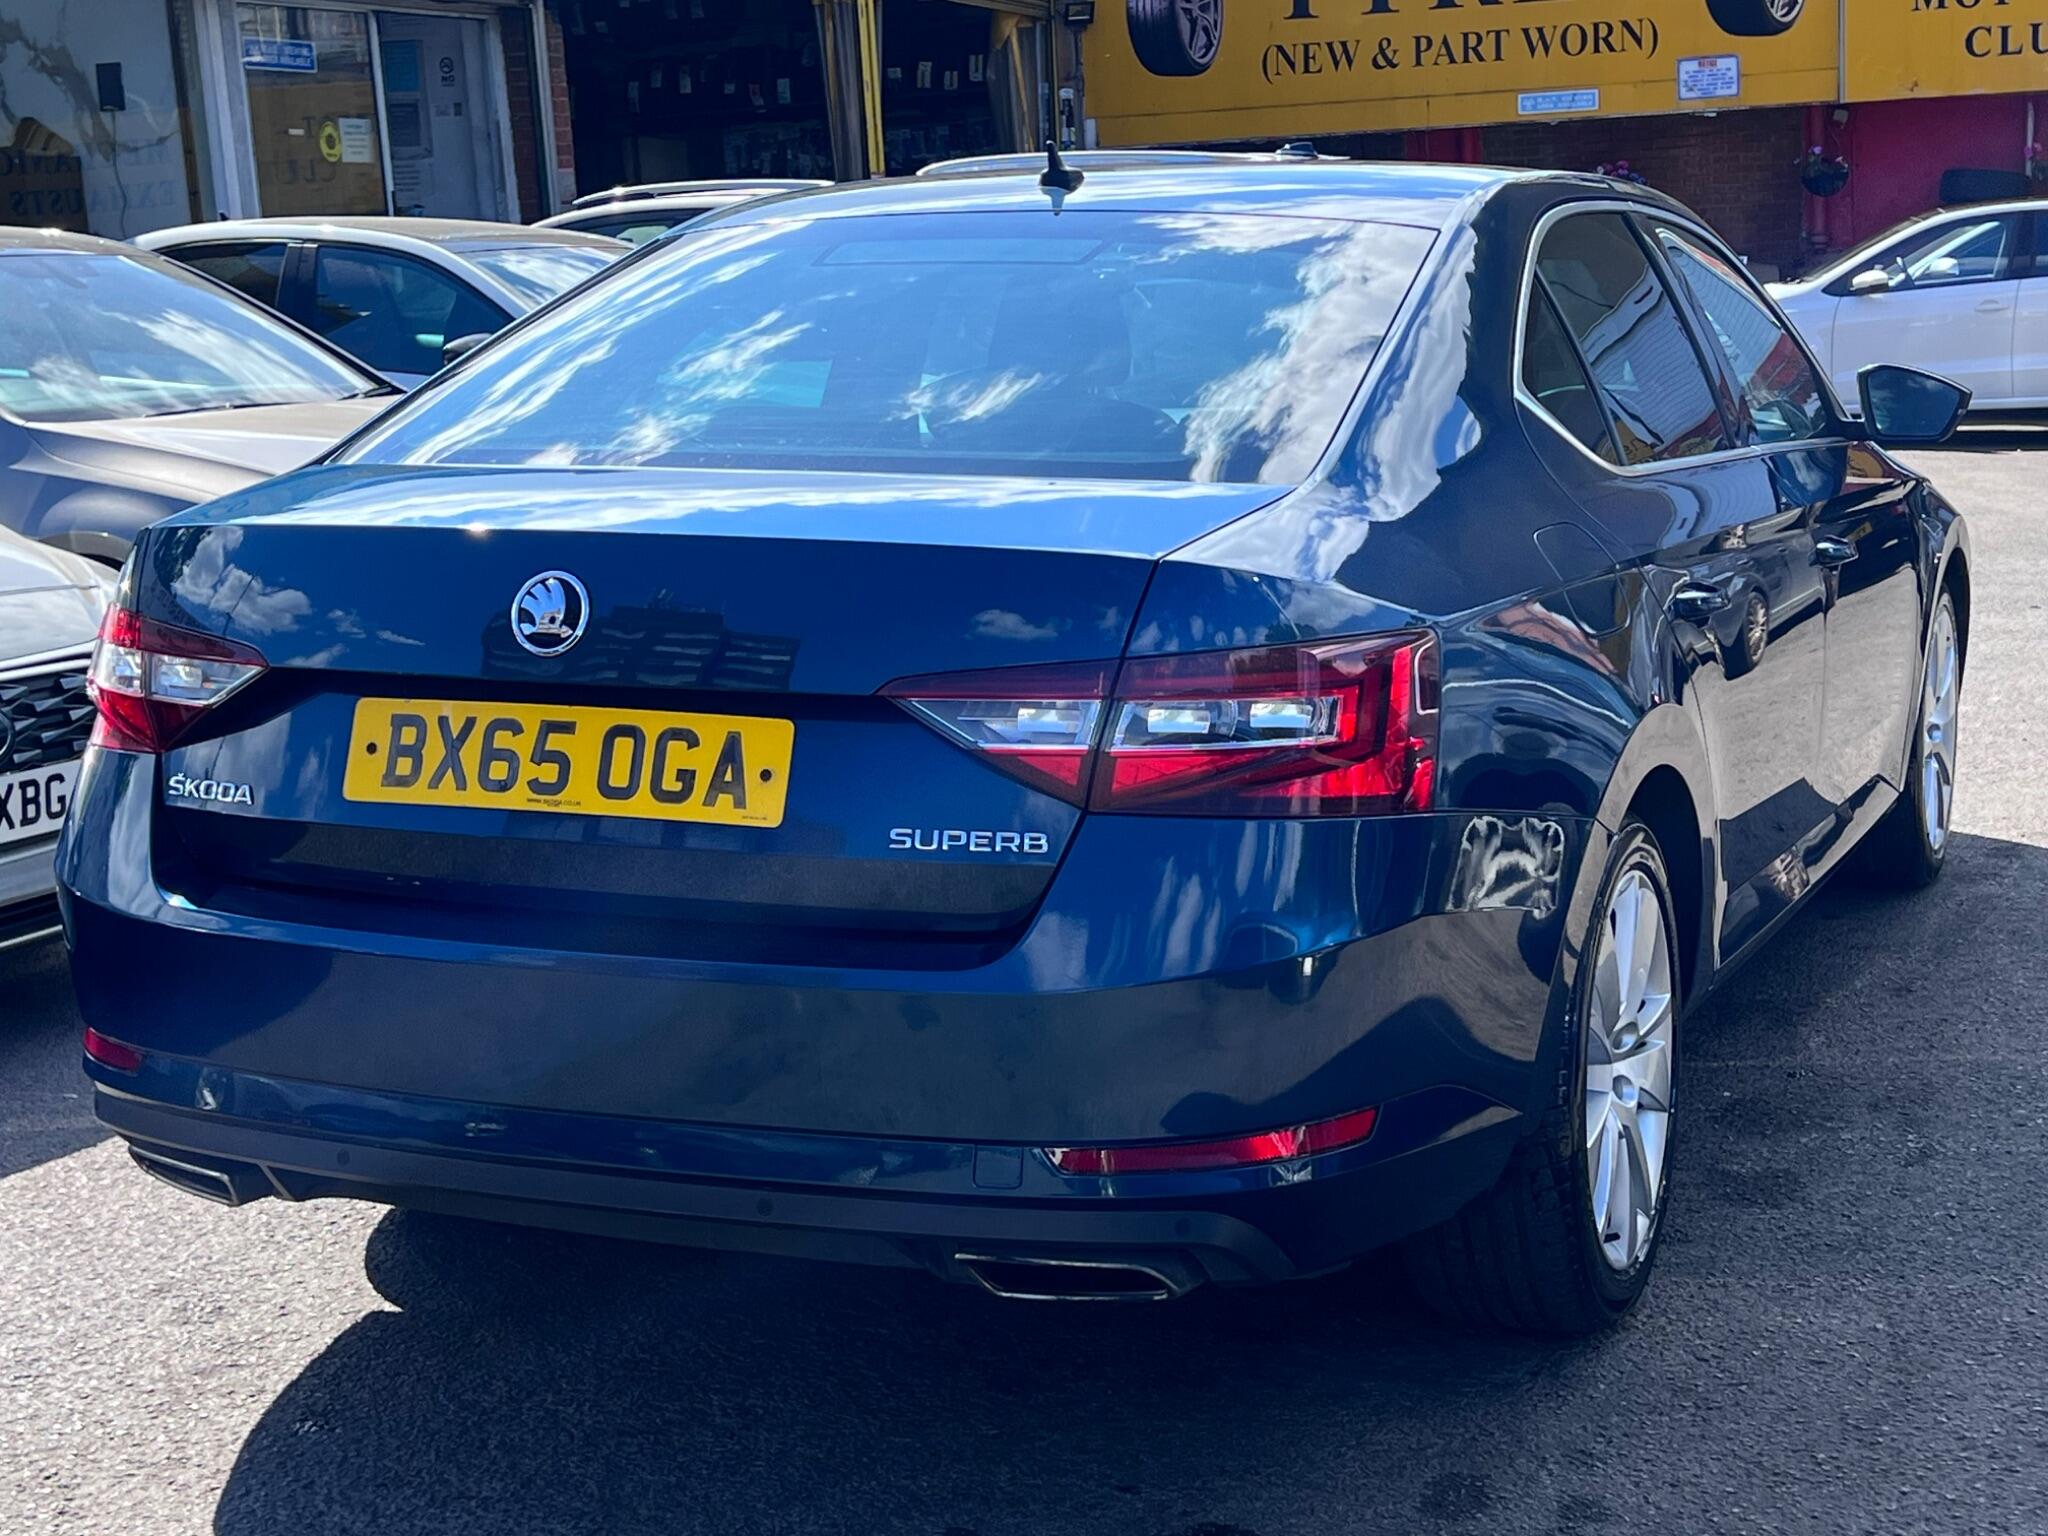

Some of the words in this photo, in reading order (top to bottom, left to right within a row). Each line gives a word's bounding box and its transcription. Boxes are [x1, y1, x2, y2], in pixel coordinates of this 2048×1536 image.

[1262, 39, 1360, 85] (NEW
[1371, 36, 1400, 71] &
[1412, 28, 1510, 68] PART
[1521, 17, 1659, 60] WORN)
[1964, 22, 2048, 58] CLU
[380, 713, 577, 797] BX65
[596, 723, 748, 810] OGA
[168, 772, 252, 805] ŠKODA
[889, 828, 1049, 853] SUPERB
